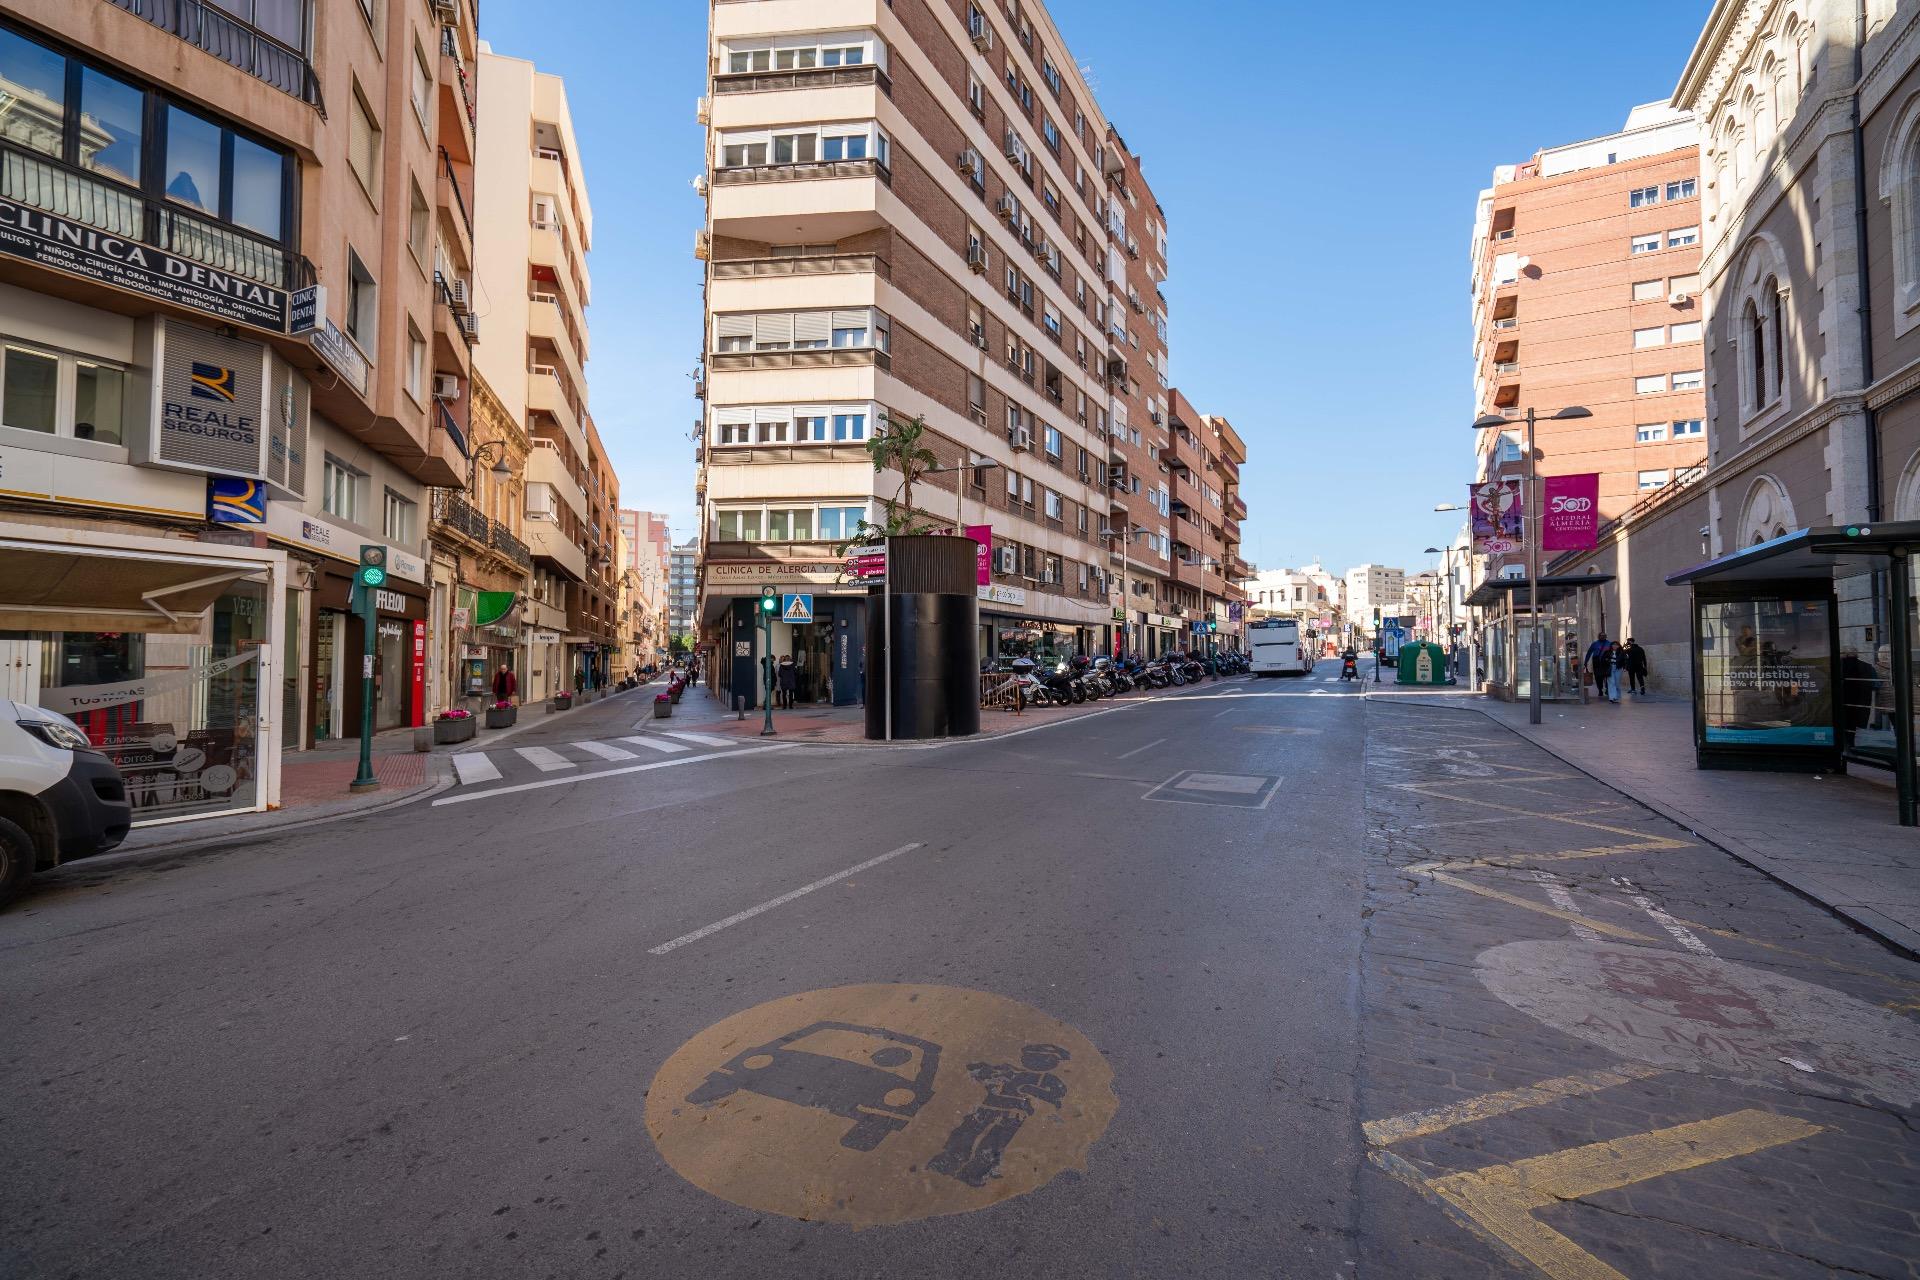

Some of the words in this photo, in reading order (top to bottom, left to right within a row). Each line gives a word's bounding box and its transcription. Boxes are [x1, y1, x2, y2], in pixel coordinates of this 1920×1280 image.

[0, 202, 148, 267] CLINICA
[165, 257, 280, 308] DENTAL
[36, 252, 103, 277] PERIODONCIA
[113, 275, 173, 298] ENDODONCIA
[181, 295, 216, 311] ESTÉTICA
[218, 307, 246, 320] DENTAL
[44, 245, 75, 260] NIÑOS
[85, 258, 124, 274] CIRUGÍA
[127, 271, 150, 283] ORAL
[158, 280, 224, 305] IMPLANTOLOGÍA
[231, 302, 281, 322] ORTODONCIA
[292, 303, 316, 321] DENTAL
[165, 402, 254, 432] REALE
[164, 420, 255, 444] SEGUROS
[1550, 514, 1591, 522] CATEDRAL
[311, 524, 330, 538] REALE
[311, 533, 330, 545] SEGUROS
[758, 565, 773, 574] DE
[822, 565, 829, 573] Y
[1723, 670, 1810, 679] combustibles
[1749, 680, 1817, 688] renovables
[102, 735, 139, 745] ZUMOS
